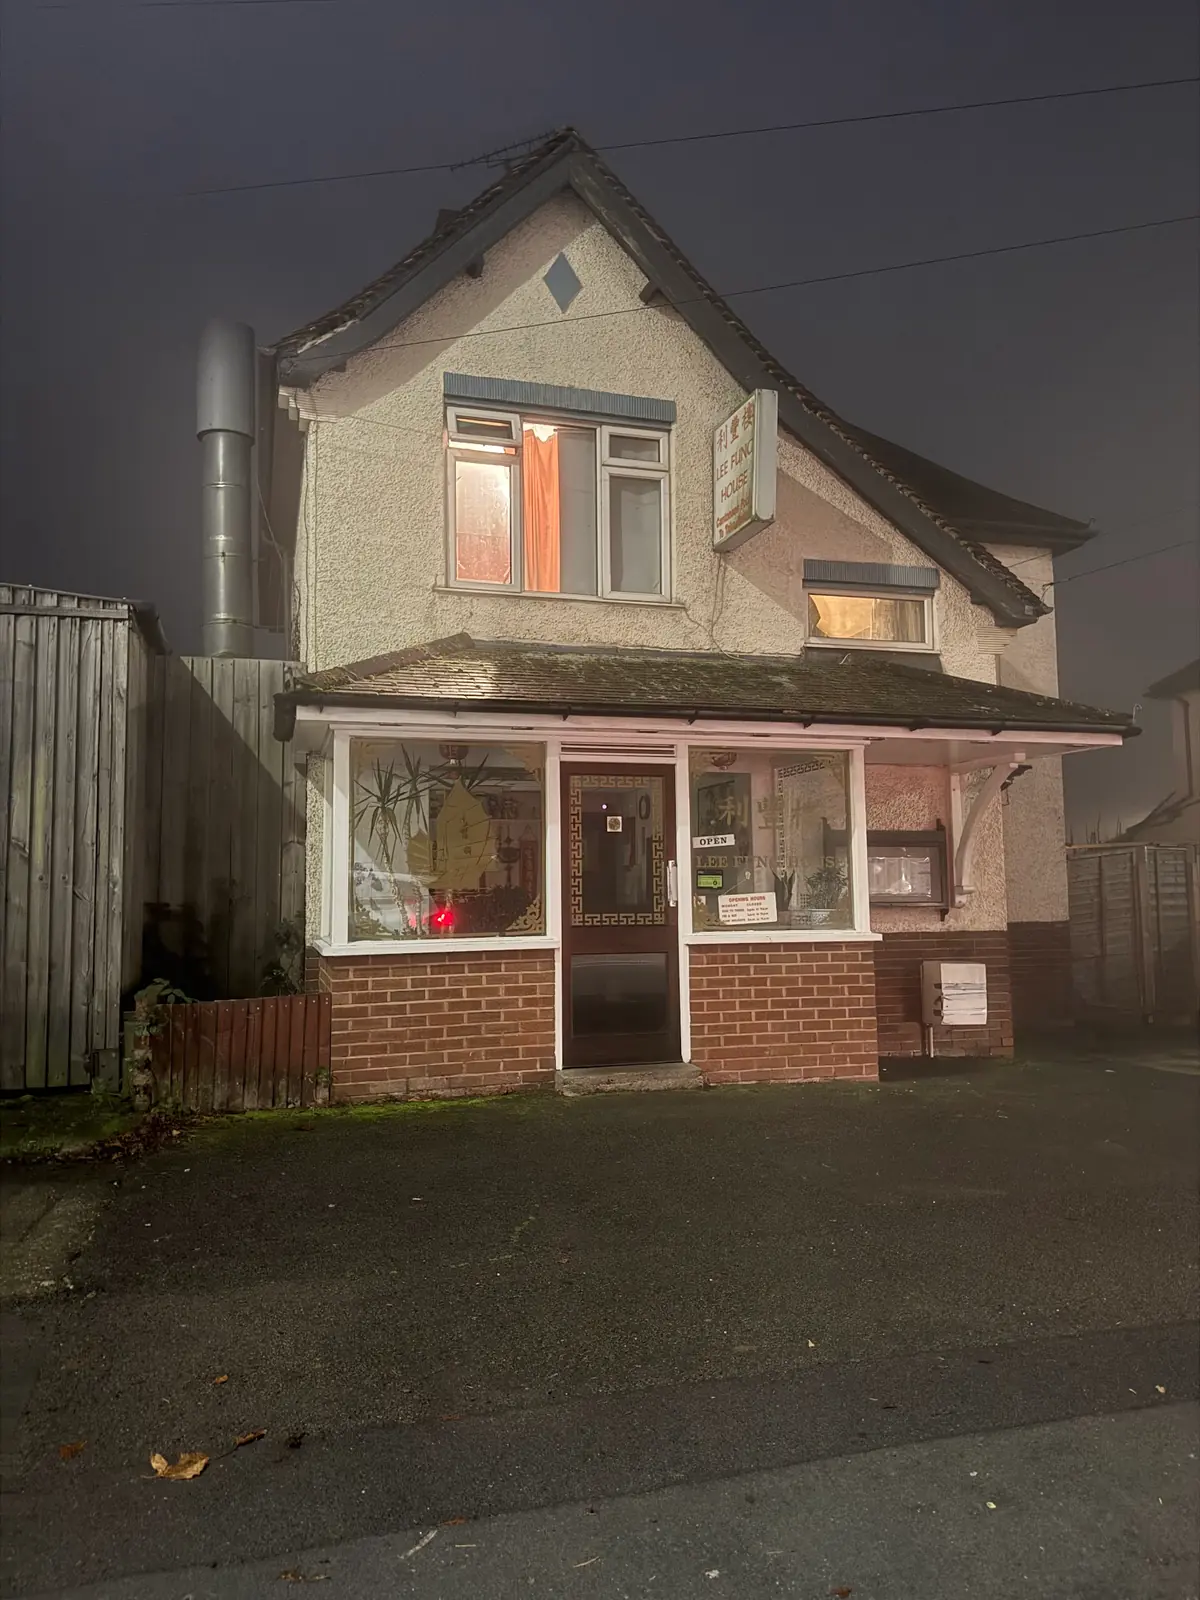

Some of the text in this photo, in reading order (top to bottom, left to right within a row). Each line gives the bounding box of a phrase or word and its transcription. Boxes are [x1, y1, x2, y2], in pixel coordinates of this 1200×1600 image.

[717, 460, 728, 481] LEE
[721, 468, 748, 503] HOUSE
[699, 836, 728, 846] OPEN
[696, 855, 728, 868] LEE
